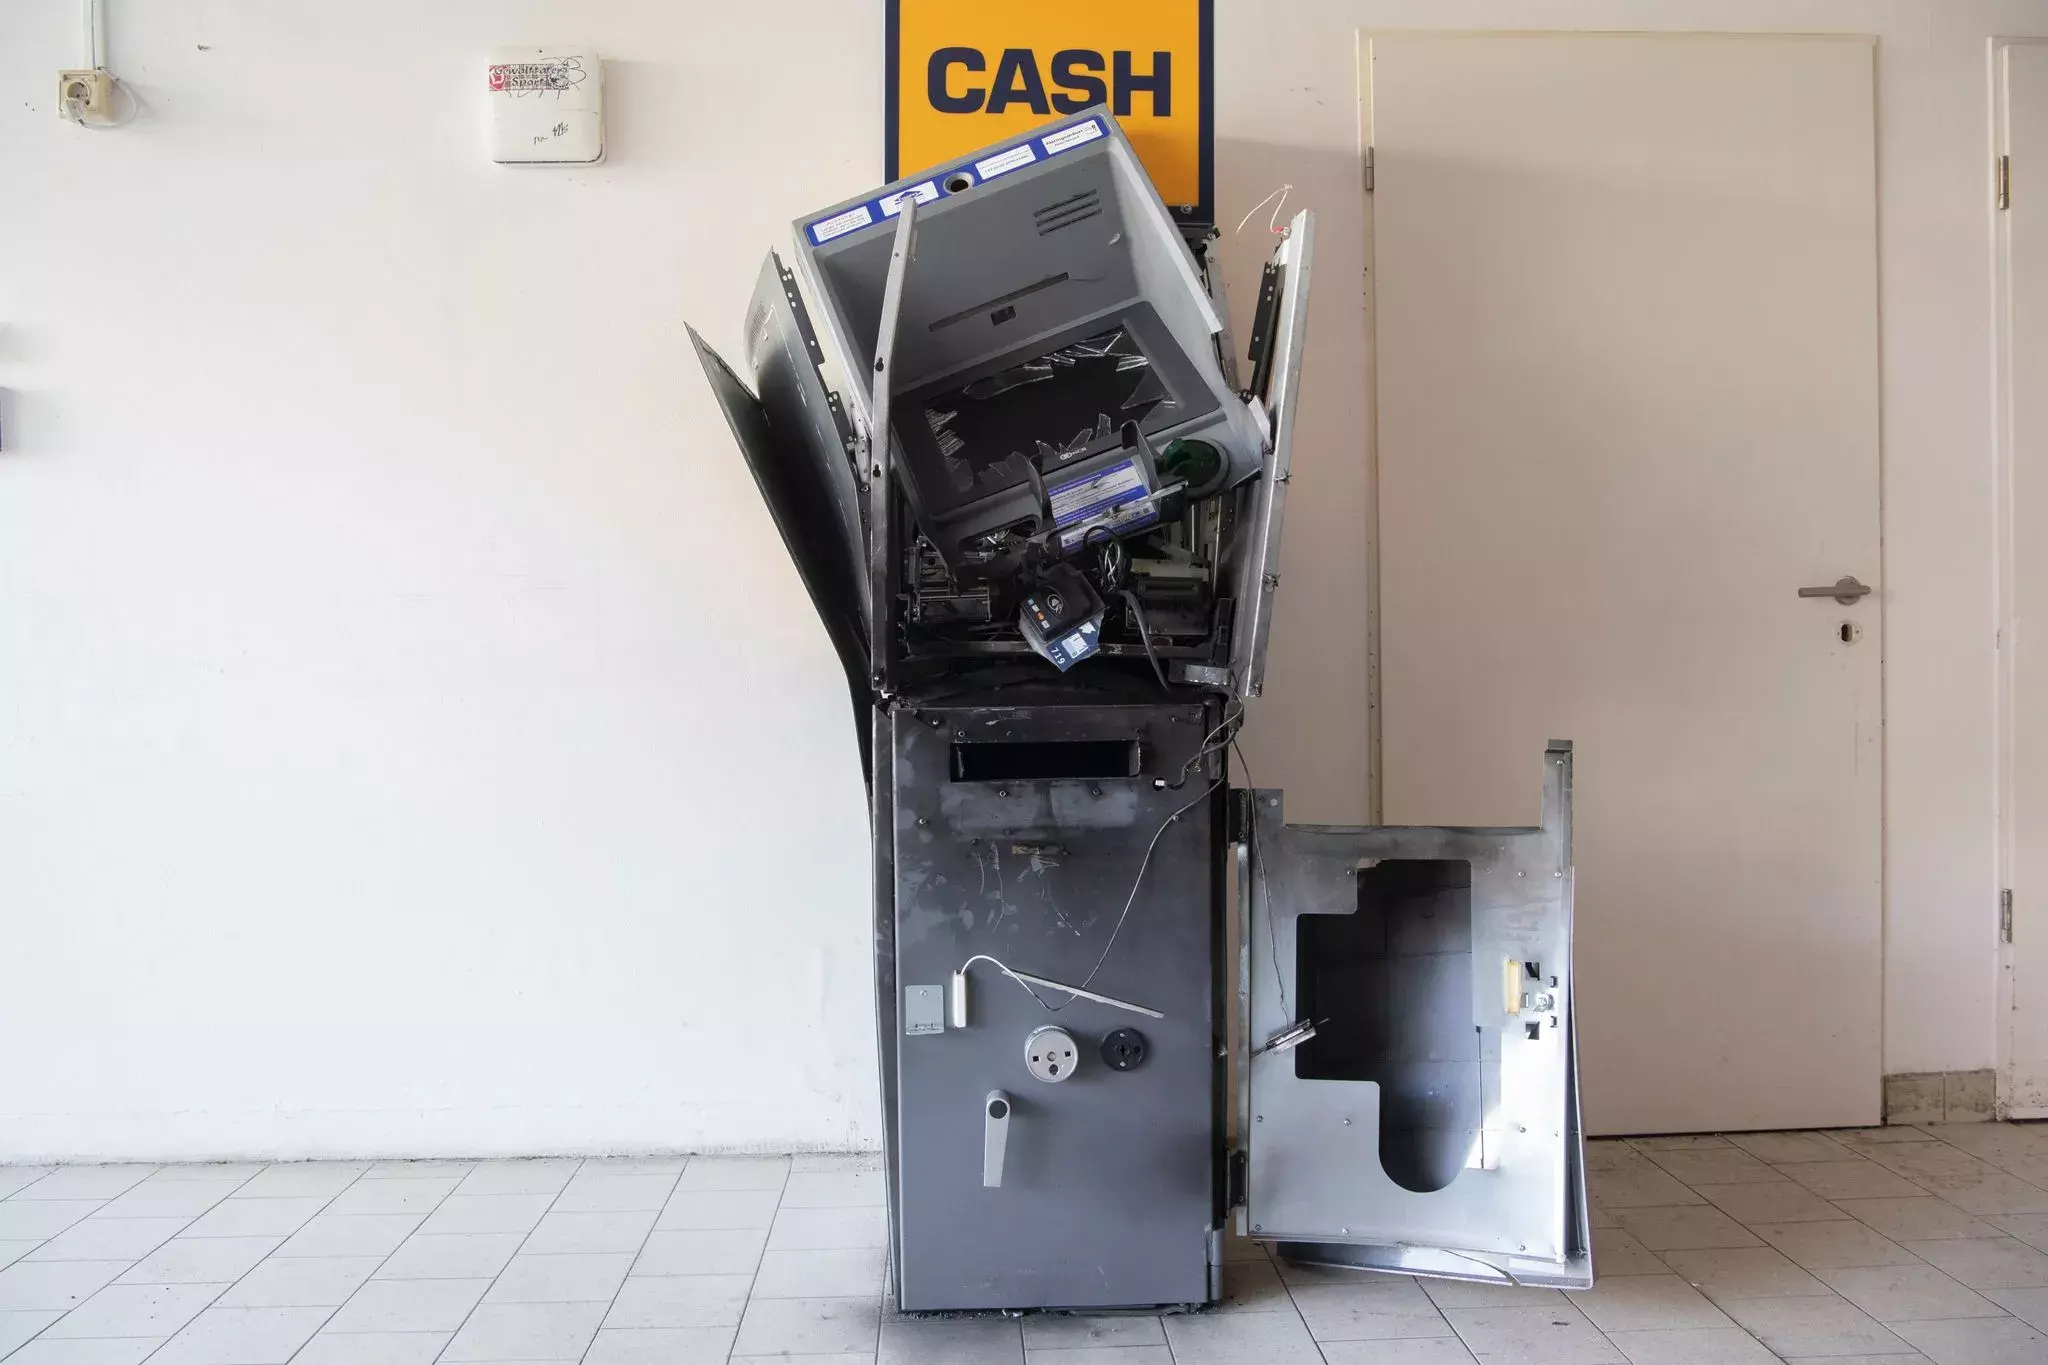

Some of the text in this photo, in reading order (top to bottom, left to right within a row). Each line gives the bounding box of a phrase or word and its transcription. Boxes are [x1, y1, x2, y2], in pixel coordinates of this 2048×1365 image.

[511, 76, 545, 88] Sport
[927, 46, 1172, 117] CASH
[1050, 646, 1066, 665] 719
